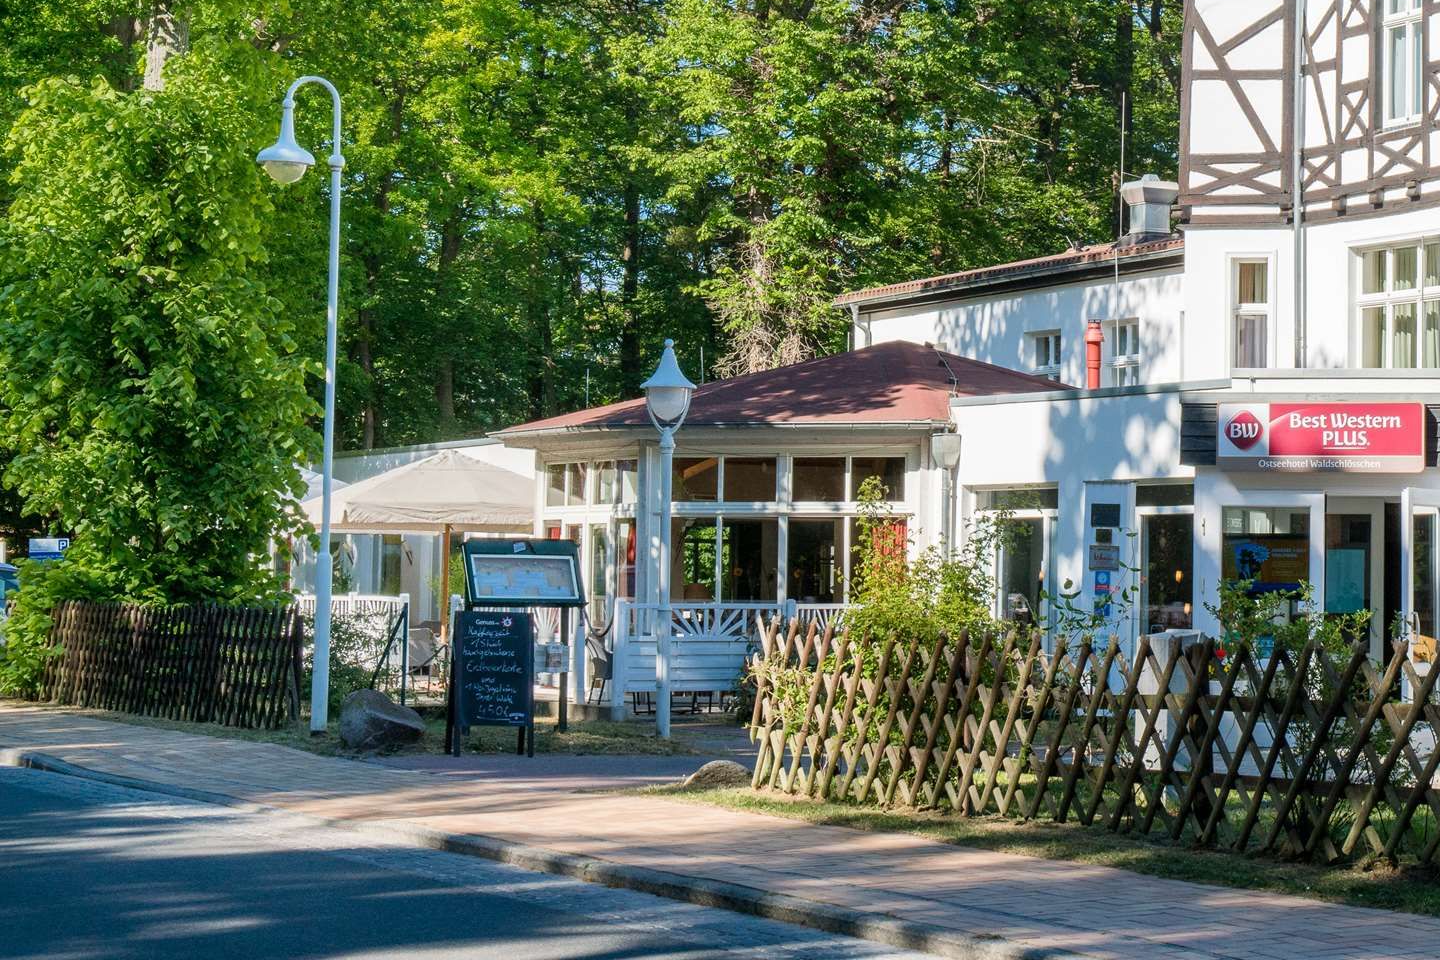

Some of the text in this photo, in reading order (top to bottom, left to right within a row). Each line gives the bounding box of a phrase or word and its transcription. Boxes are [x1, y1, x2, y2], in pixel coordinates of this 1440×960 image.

[1289, 413, 1401, 428] Best Western
[1230, 423, 1258, 438] BW
[1258, 459, 1380, 469] Ostseehotel Waldschlösschen
